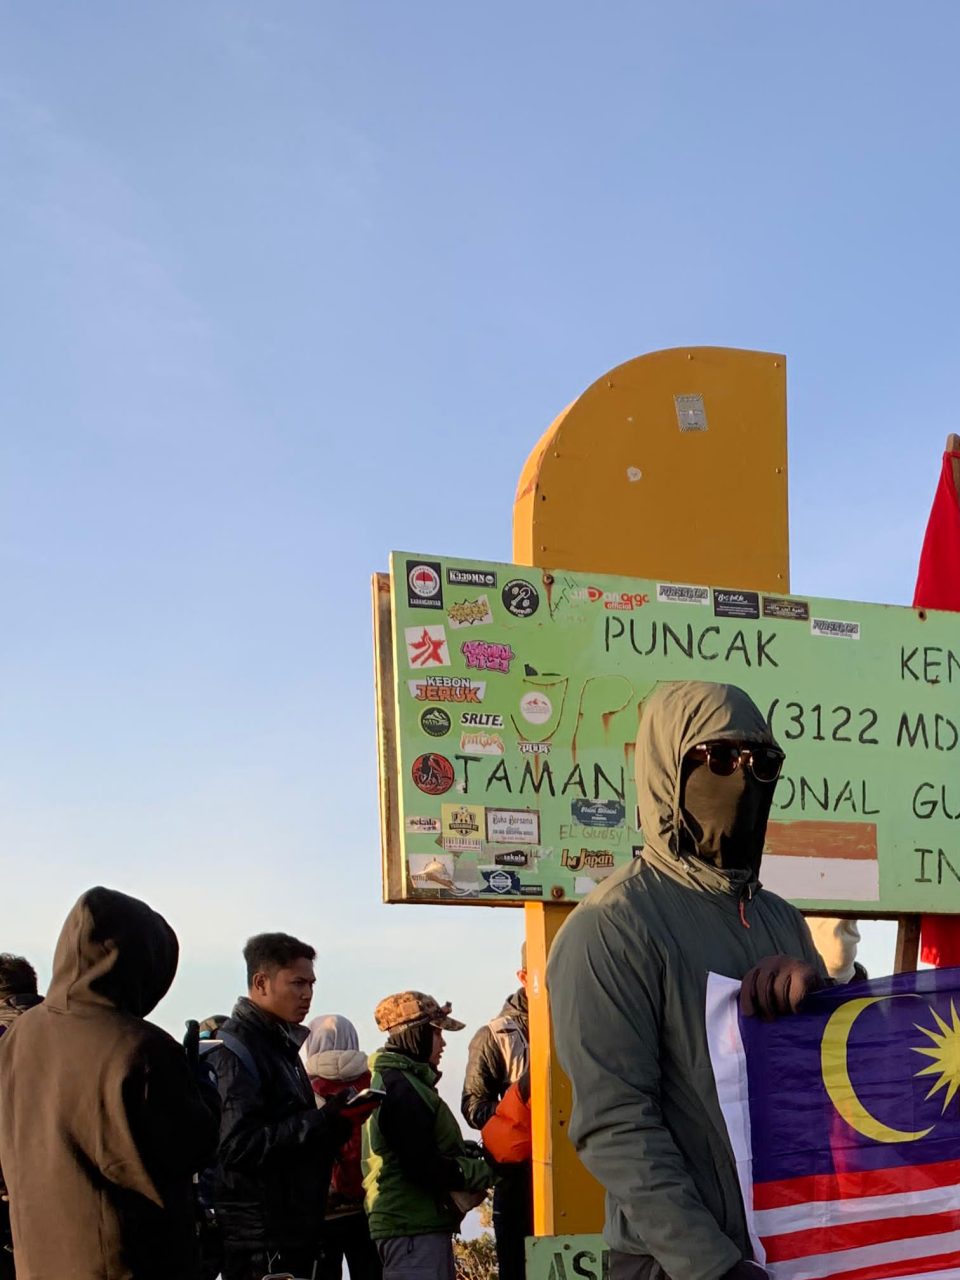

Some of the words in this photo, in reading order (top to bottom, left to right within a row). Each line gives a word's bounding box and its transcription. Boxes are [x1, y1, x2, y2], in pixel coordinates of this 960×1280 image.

[605, 616, 779, 668] PUNCAK
[415, 684, 482, 703] JERUK
[426, 676, 471, 688] KEBON
[461, 712, 504, 727] SRLTE.
[766, 698, 879, 745] (3122
[454, 755, 626, 800] TAMAN
[772, 775, 881, 815] ONAL
